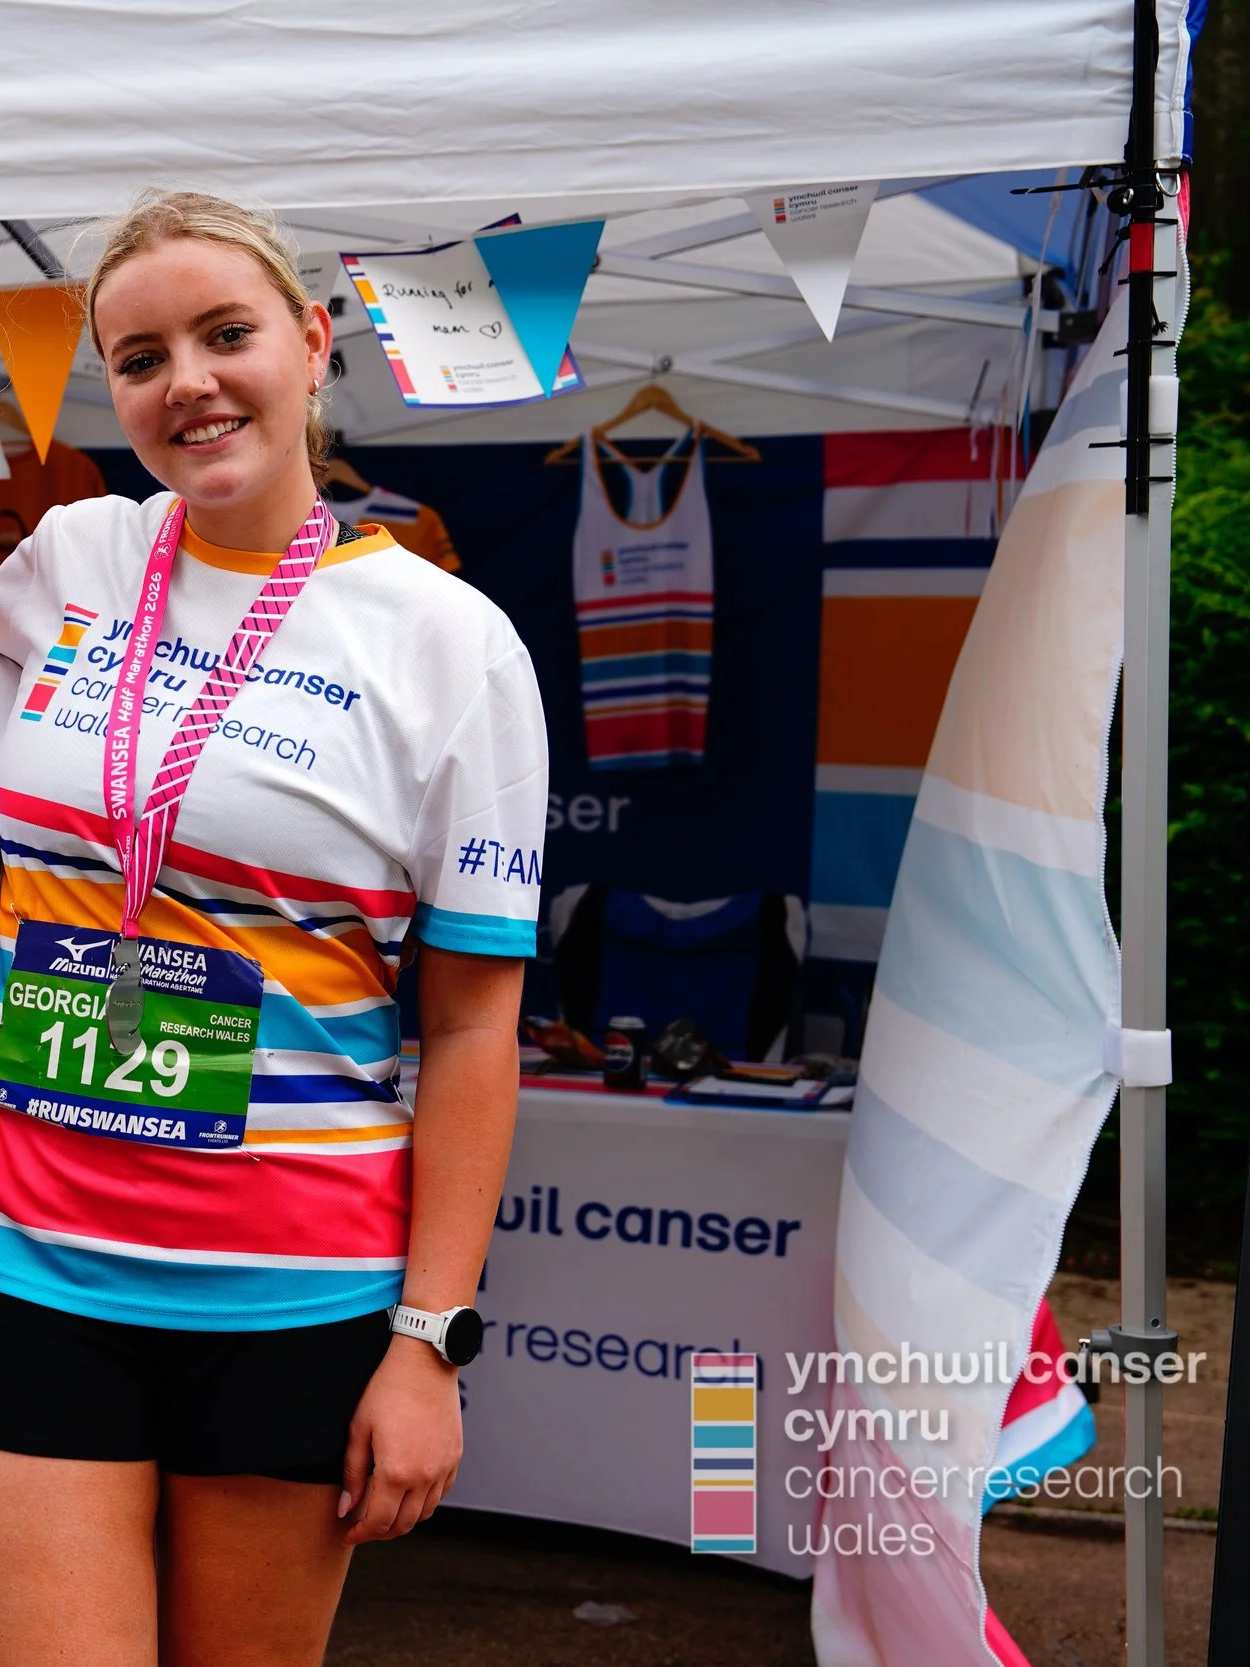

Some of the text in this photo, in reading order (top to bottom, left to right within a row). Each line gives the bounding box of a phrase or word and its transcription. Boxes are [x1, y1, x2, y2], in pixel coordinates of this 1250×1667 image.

[87, 645, 188, 692] cyru
[111, 571, 163, 821] SWANSEA Half Marathon 2026
[140, 962, 208, 987] Marathon
[170, 983, 204, 995] ABERTAWE
[159, 1021, 251, 1044] RESEARCH WALES
[209, 1013, 252, 1030] CANCER
[40, 1020, 191, 1098] 1129
[26, 1097, 187, 1141] #RUNSWANSEA
[574, 1200, 803, 1259] canser
